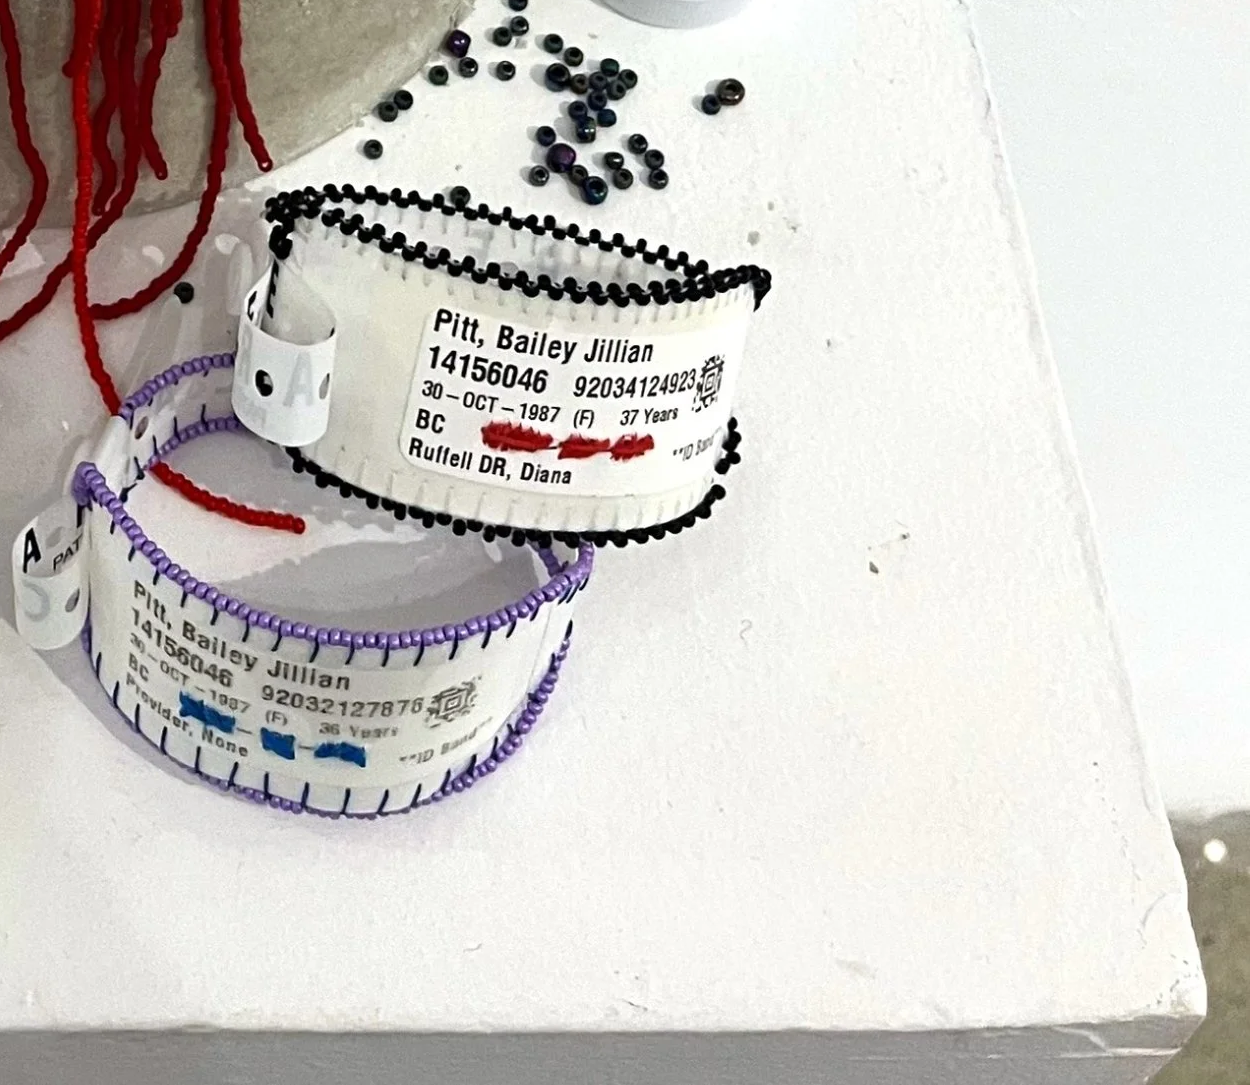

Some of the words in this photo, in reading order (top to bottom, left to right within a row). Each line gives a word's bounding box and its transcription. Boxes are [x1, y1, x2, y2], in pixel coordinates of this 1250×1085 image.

[433, 308, 484, 349] Pitt,
[496, 324, 577, 365] Bailey
[584, 338, 654, 365] Jillian
[428, 346, 548, 394] 14156046
[573, 368, 696, 400] 92034124923
[415, 408, 446, 434] BC
[573, 409, 595, 429] (F)
[620, 410, 640, 427] 37
[644, 407, 679, 426] Years
[408, 437, 473, 473] Ruffell
[477, 454, 511, 482] DR,
[521, 462, 572, 485] Diana
[23, 527, 41, 573] A
[134, 581, 172, 630] Pitt,
[182, 620, 258, 671] Bailey
[267, 659, 350, 691] Jillian
[128, 653, 150, 683] BC
[132, 607, 234, 688] 14156046
[261, 684, 424, 718] 92032127876
[201, 727, 248, 758] None
[265, 710, 288, 727] (F)
[349, 725, 399, 739] Years
